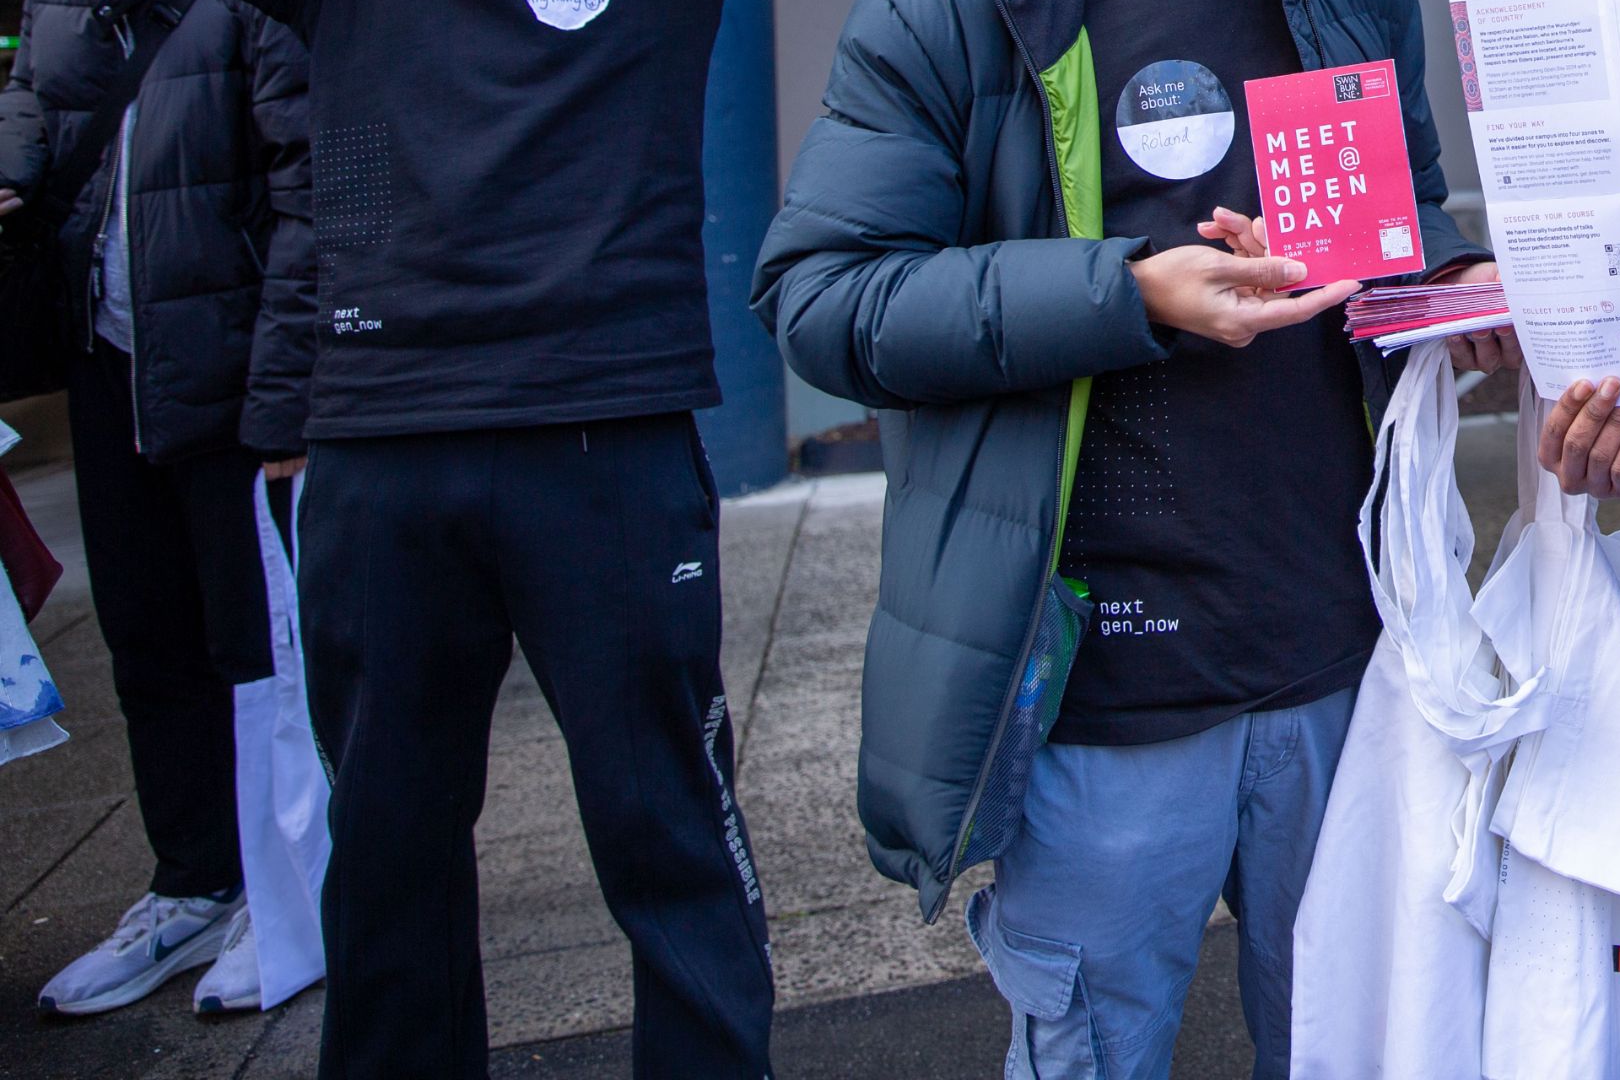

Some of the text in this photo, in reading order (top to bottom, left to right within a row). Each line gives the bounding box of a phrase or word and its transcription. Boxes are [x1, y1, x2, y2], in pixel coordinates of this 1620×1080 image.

[1475, 2, 1545, 15] ACKNOWLEDGEMENT
[1335, 74, 1359, 86] SWIN
[1340, 83, 1358, 93] BUR
[1139, 81, 1185, 97] Ask me
[1141, 94, 1182, 110] about:
[1486, 119, 1544, 131] FIND YOUR WAY
[1141, 126, 1193, 151] Roland
[1266, 121, 1357, 153] MEET
[1270, 147, 1360, 180] ME @
[1274, 173, 1367, 207] OPEN
[1278, 203, 1344, 233] DAY
[1503, 210, 1594, 223] DISCOVER YOUR COURSE
[1296, 240, 1312, 249] JULY
[1315, 237, 1332, 247] 2024
[334, 307, 360, 319] next
[1522, 304, 1597, 315] COLLECT YOUR INFO
[334, 319, 383, 335] gen_now
[1100, 598, 1144, 615] next
[1101, 619, 1179, 636] gen_now
[724, 813, 761, 905] POSSIBLE
